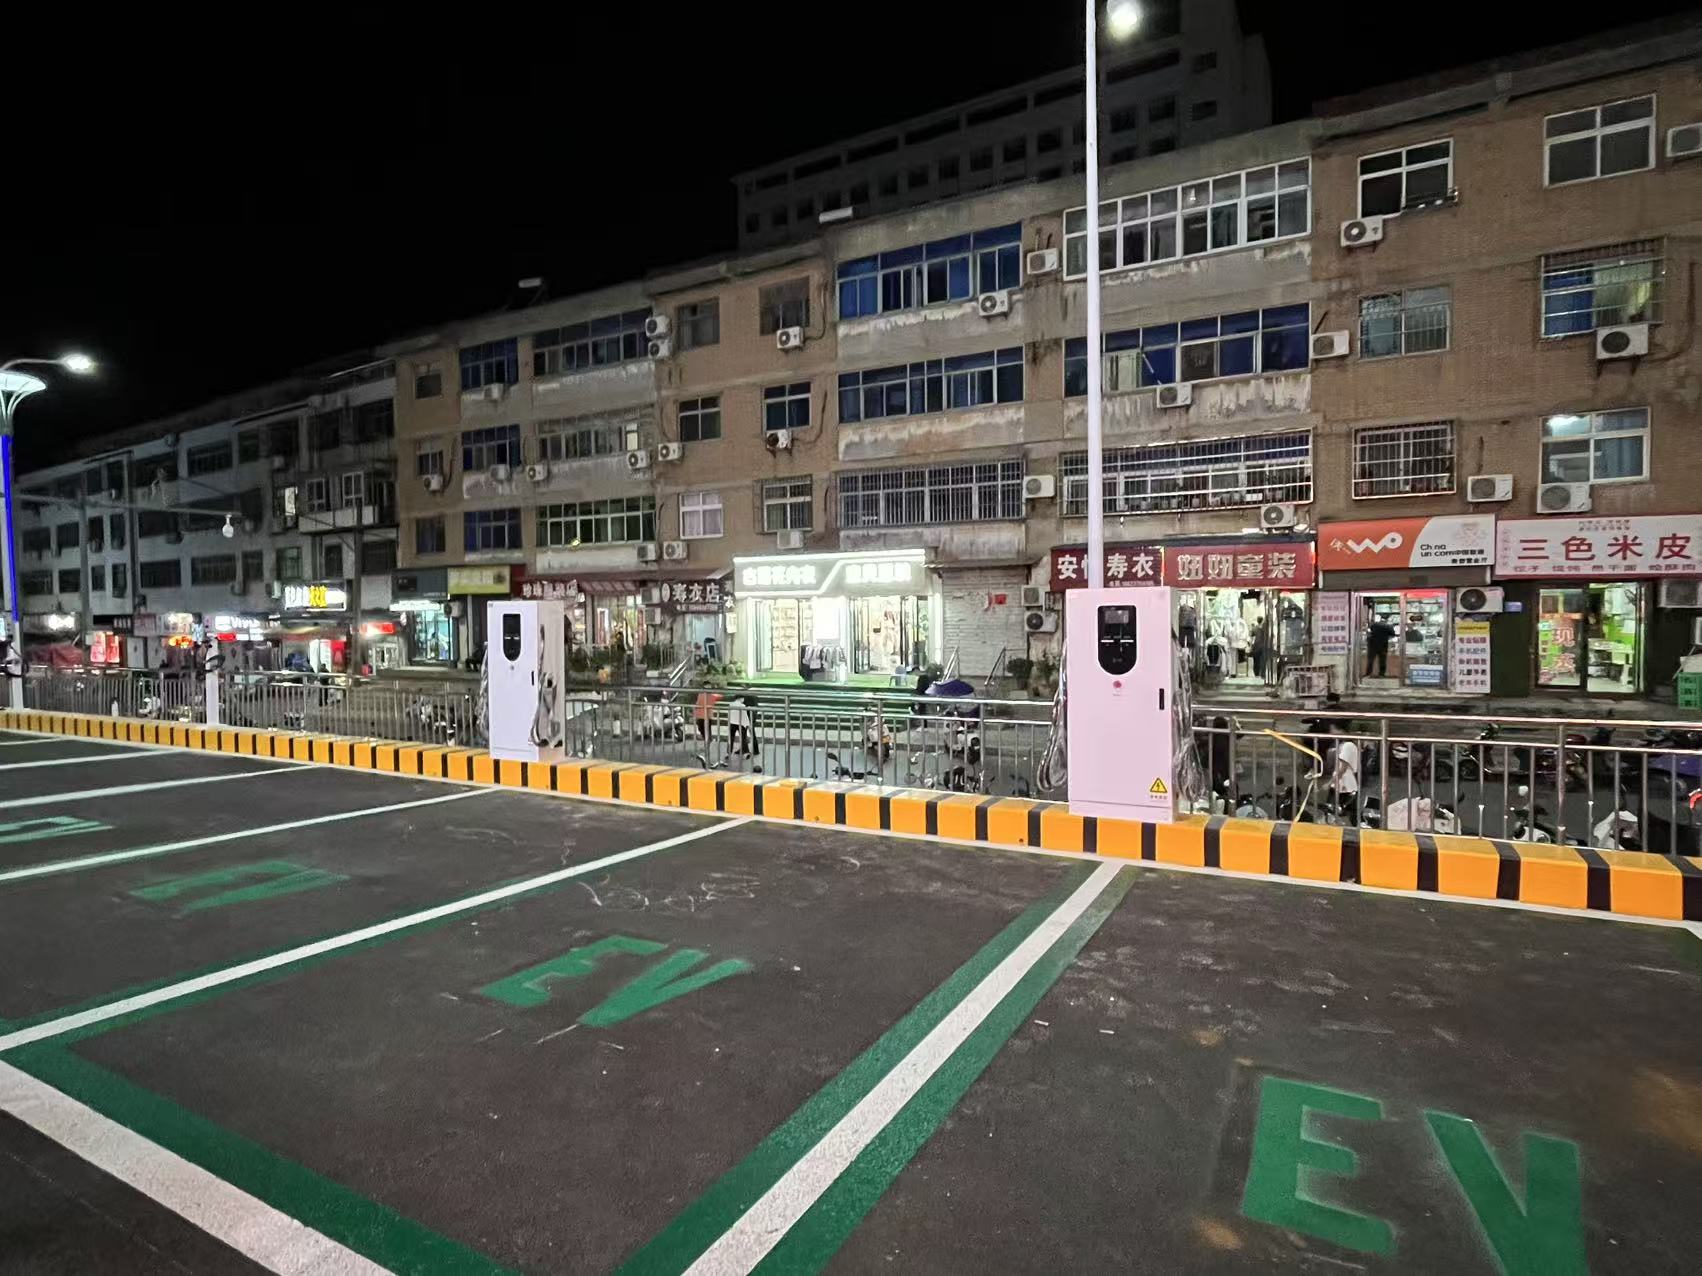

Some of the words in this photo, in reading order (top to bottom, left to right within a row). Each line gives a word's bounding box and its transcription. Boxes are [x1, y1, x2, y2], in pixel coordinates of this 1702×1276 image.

[1517, 533, 1692, 561] 三色米皮
[480, 934, 753, 1028] EV
[1240, 1074, 1592, 1276] EV
